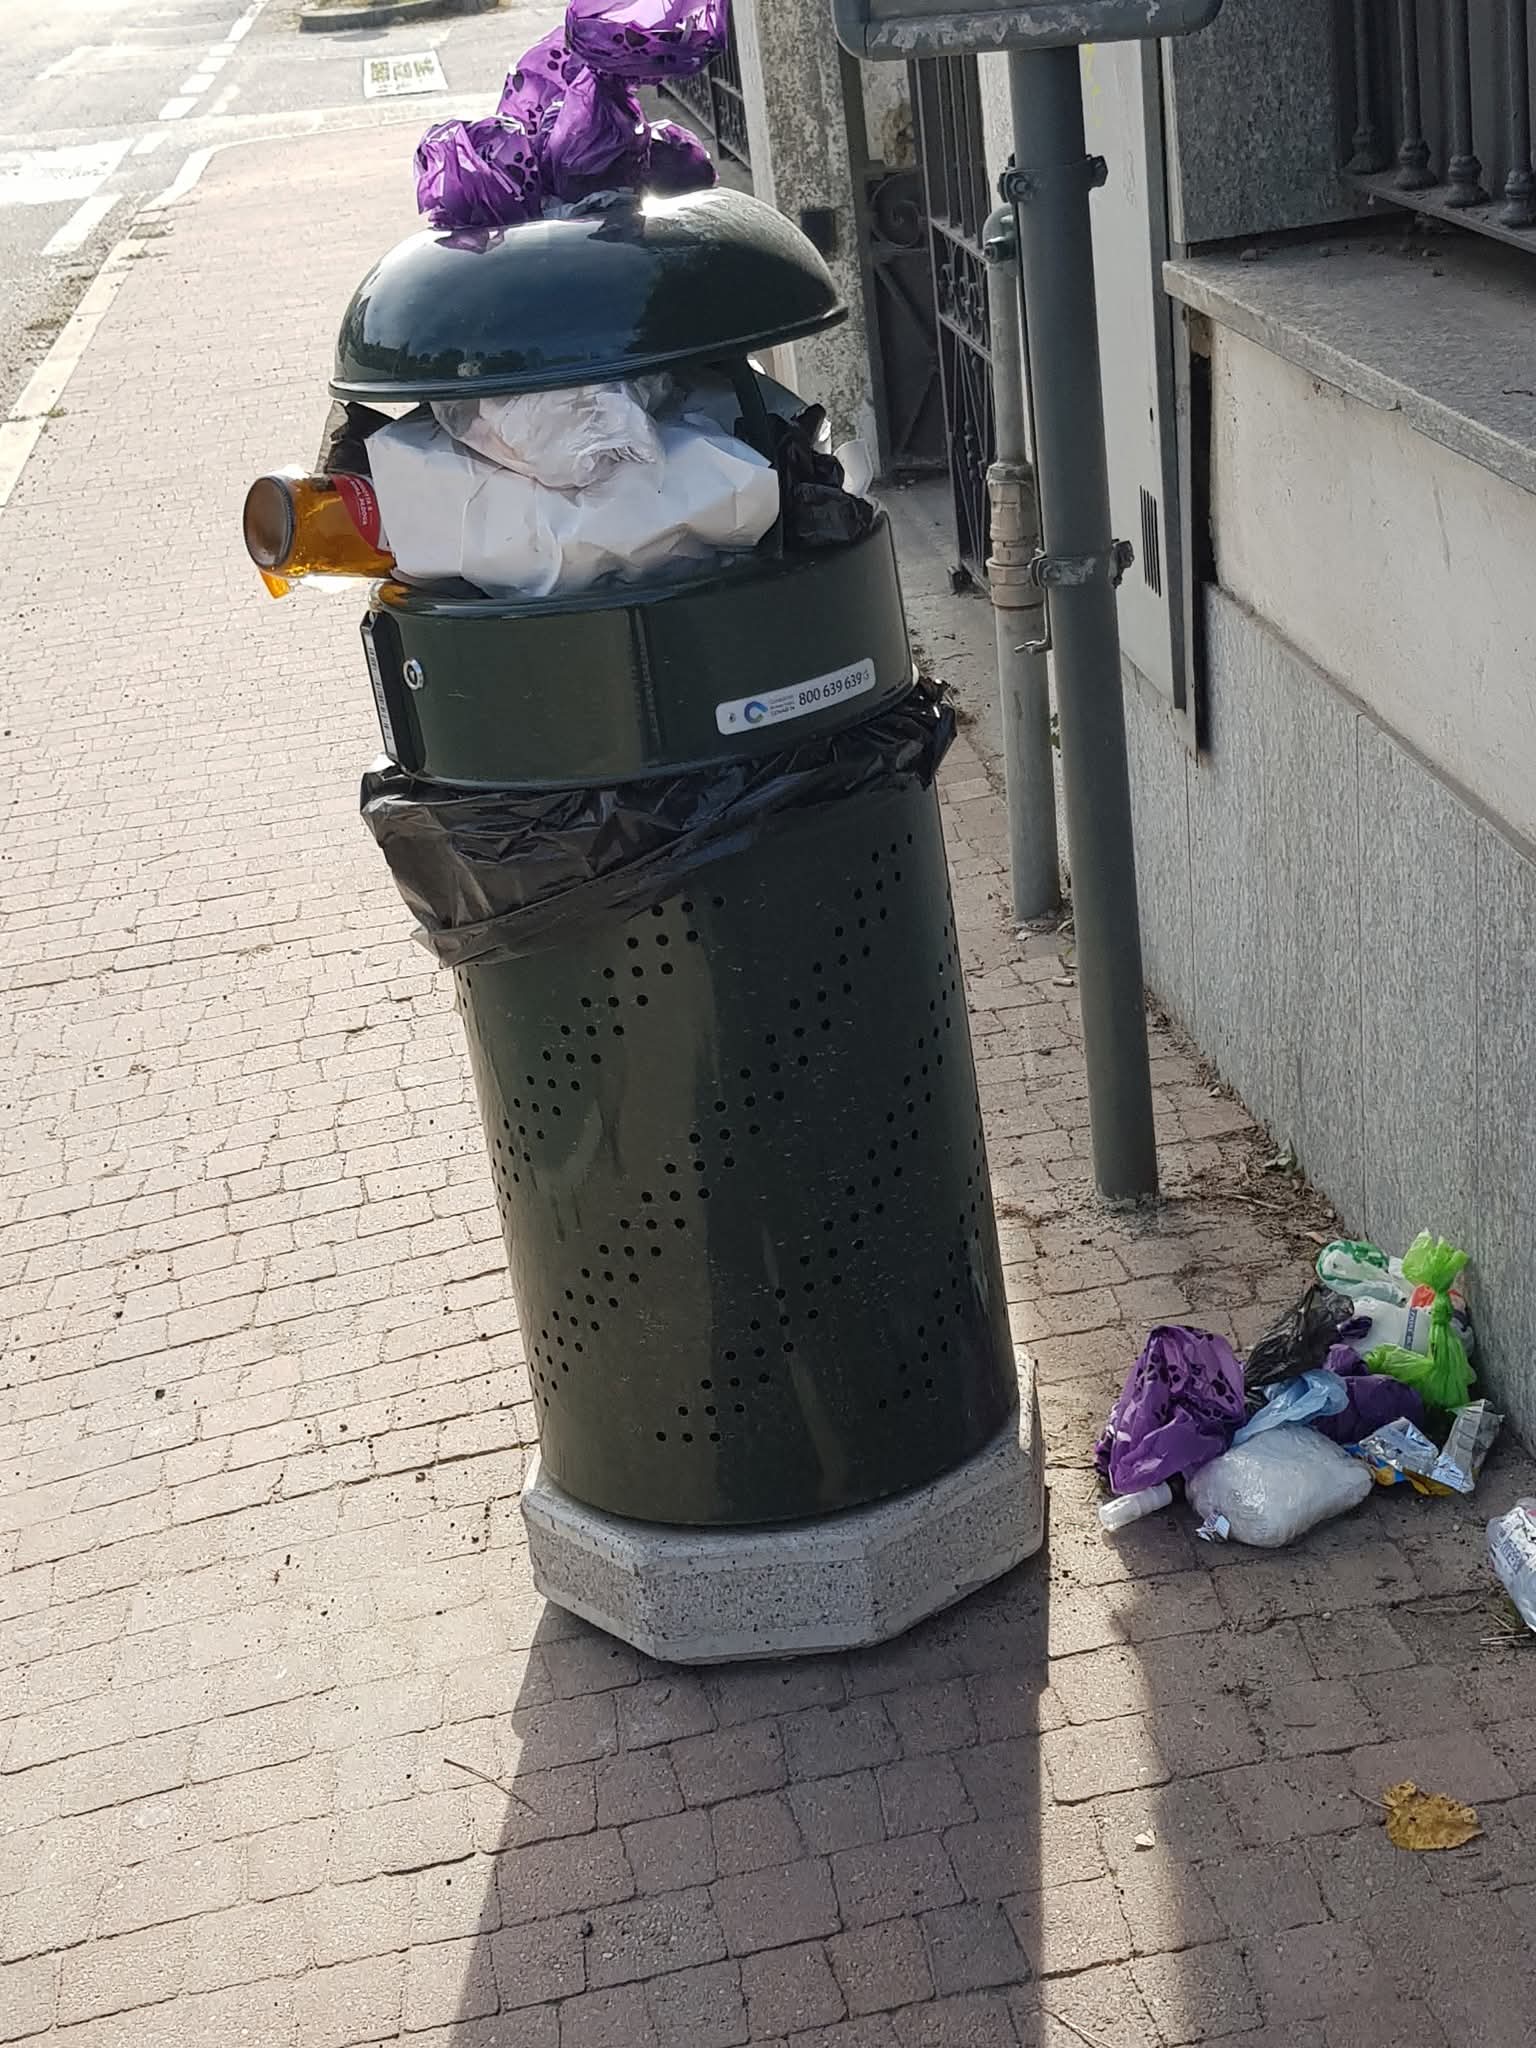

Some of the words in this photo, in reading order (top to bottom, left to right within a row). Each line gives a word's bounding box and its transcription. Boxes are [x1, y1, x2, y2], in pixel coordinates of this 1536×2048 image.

[799, 687, 821, 706] 800
[823, 680, 843, 698] 639
[844, 671, 862, 690] 639
